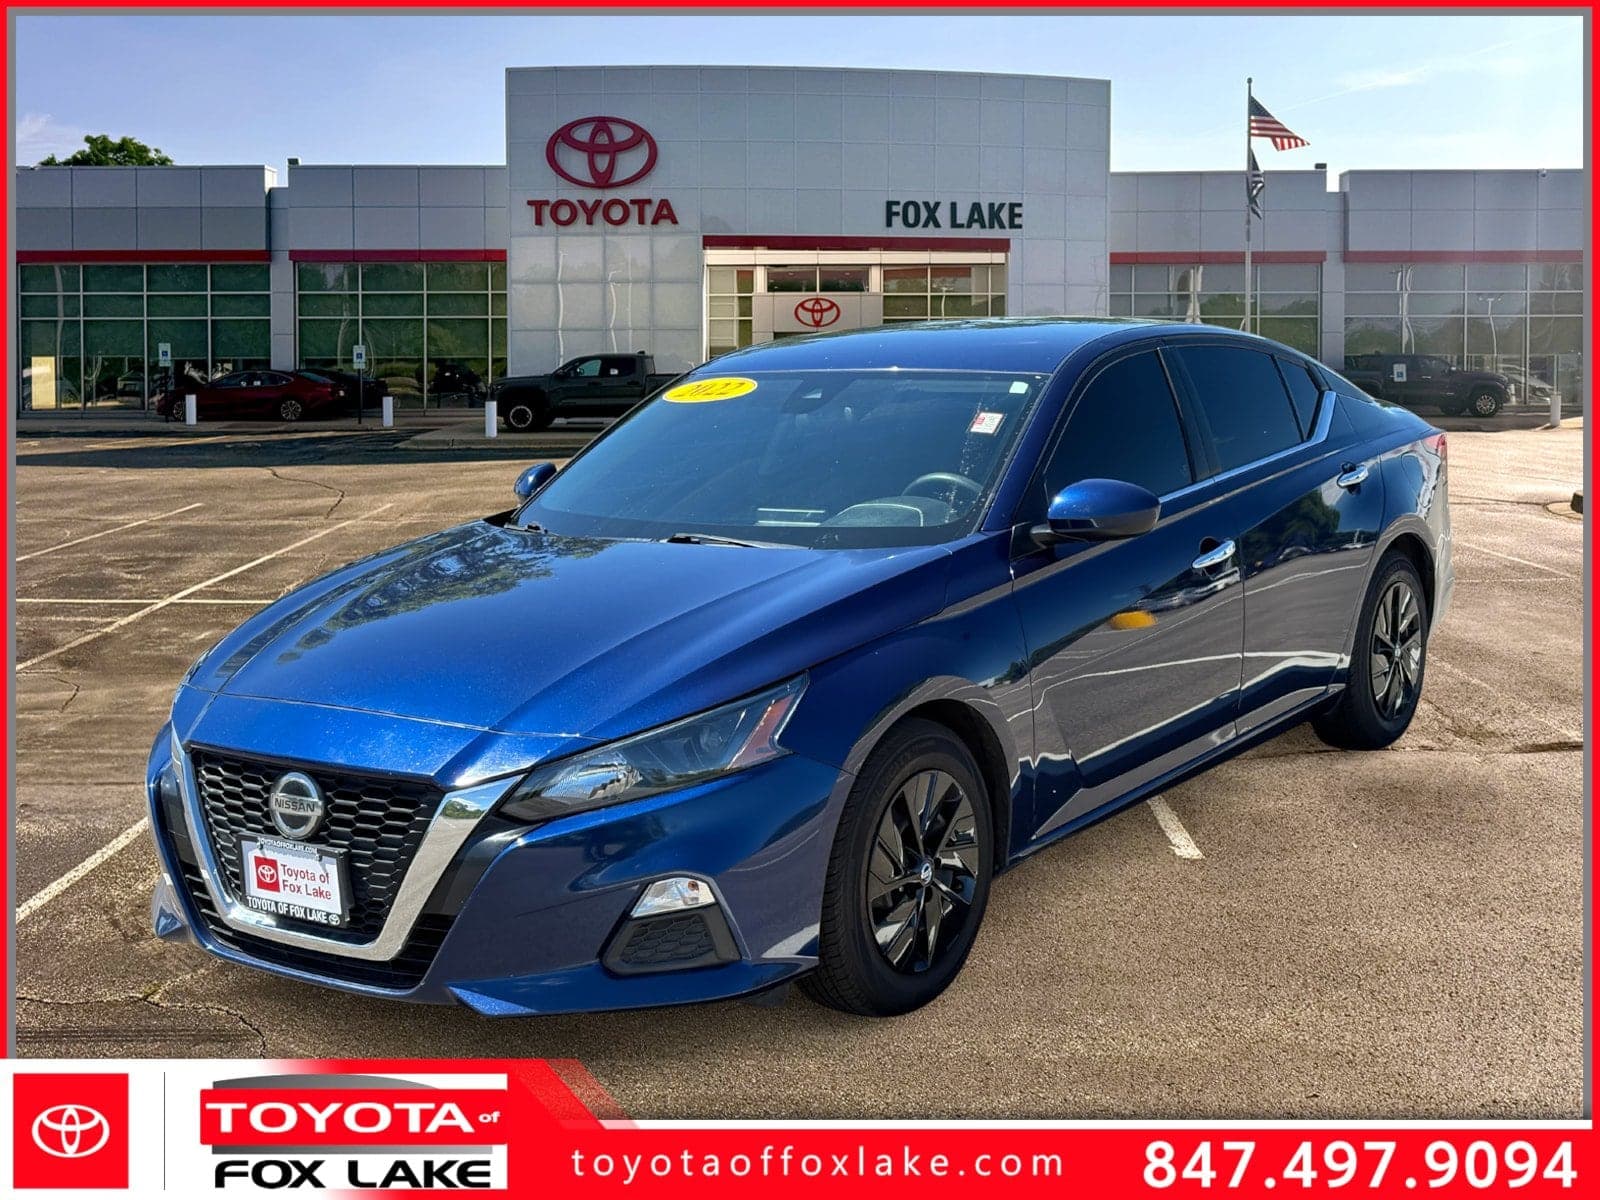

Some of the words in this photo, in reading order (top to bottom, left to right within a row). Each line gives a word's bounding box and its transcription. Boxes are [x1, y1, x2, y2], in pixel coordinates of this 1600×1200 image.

[526, 198, 679, 227] TOYOTA
[885, 200, 941, 229] FOX
[949, 201, 1023, 230] LAKE
[672, 382, 747, 398] 2022
[274, 798, 316, 813] NISSAN
[280, 863, 316, 882] Toyota
[319, 872, 330, 884] of
[282, 880, 303, 894] Fox
[305, 884, 331, 900] Lake
[247, 897, 276, 913] TOYOTA
[277, 903, 289, 915] OF
[289, 906, 306, 919] FOX
[306, 909, 328, 924] LAKE
